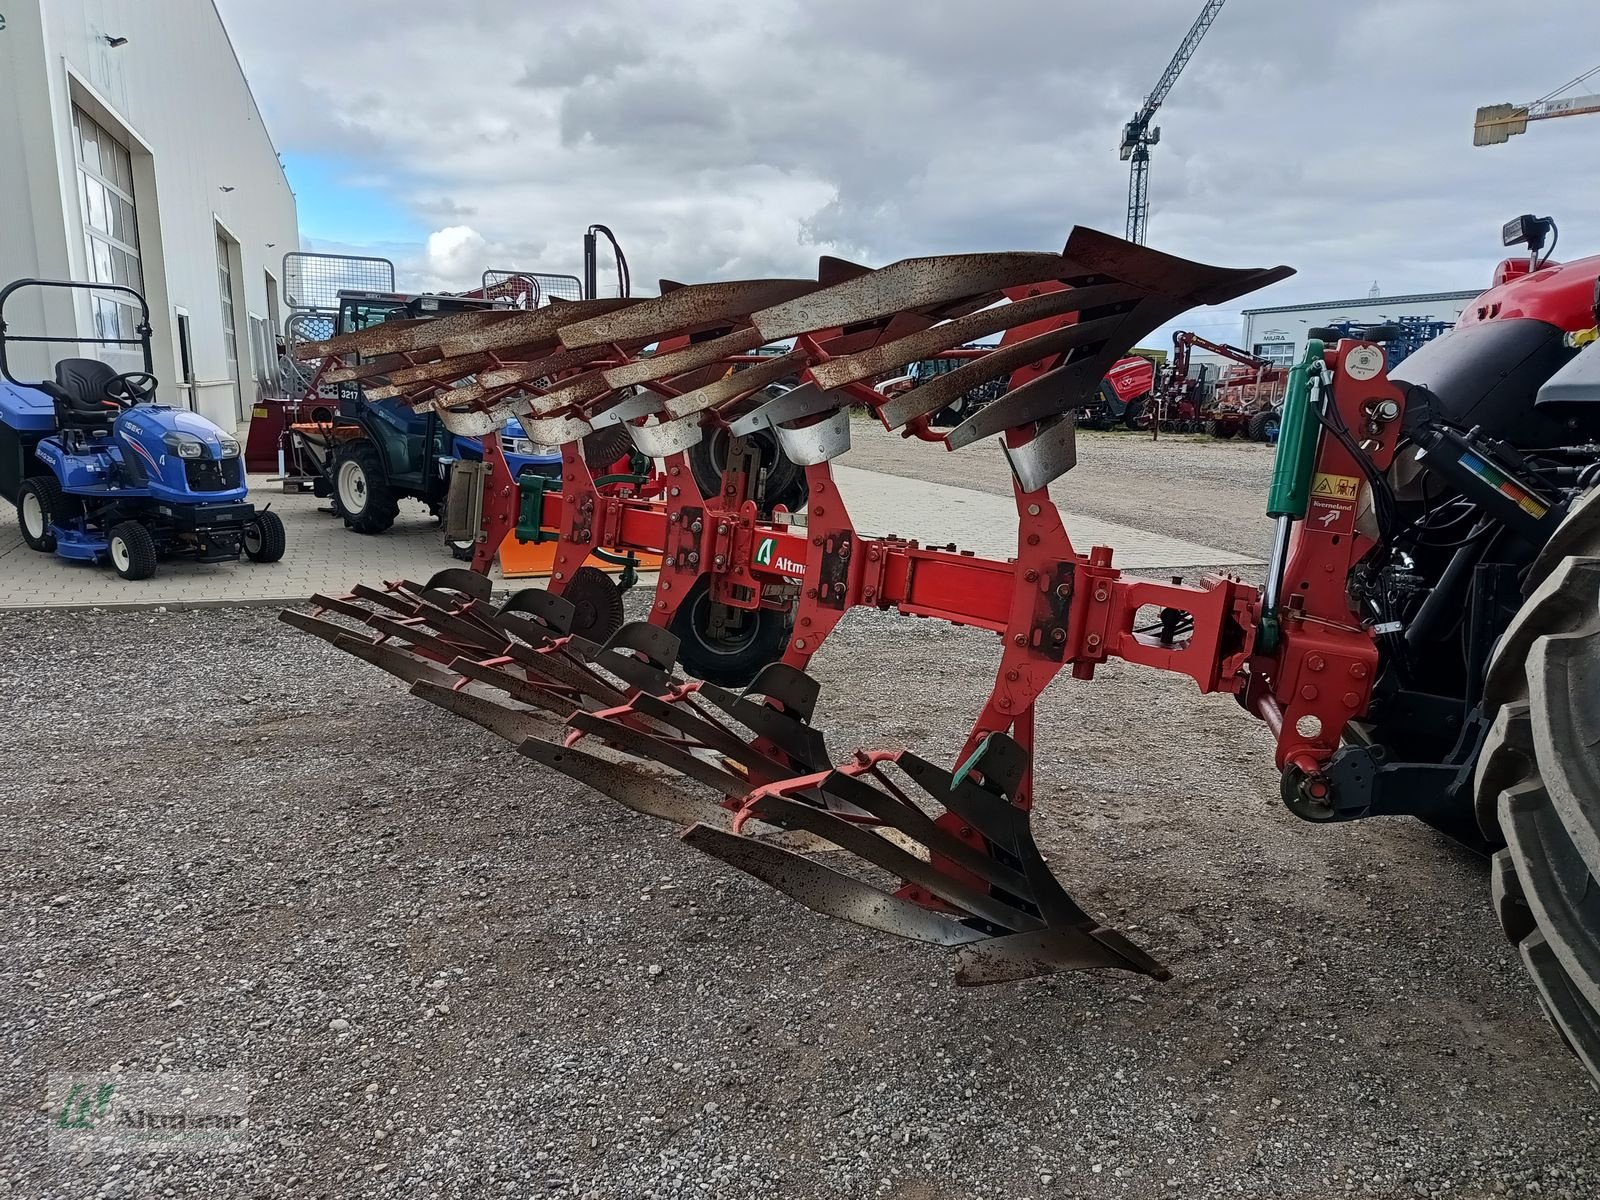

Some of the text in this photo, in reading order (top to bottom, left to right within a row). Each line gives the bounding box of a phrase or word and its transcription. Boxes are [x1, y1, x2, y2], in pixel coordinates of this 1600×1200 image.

[341, 390, 359, 400] 3217
[124, 421, 144, 436] ISEKI
[1313, 500, 1353, 511] Kverneland
